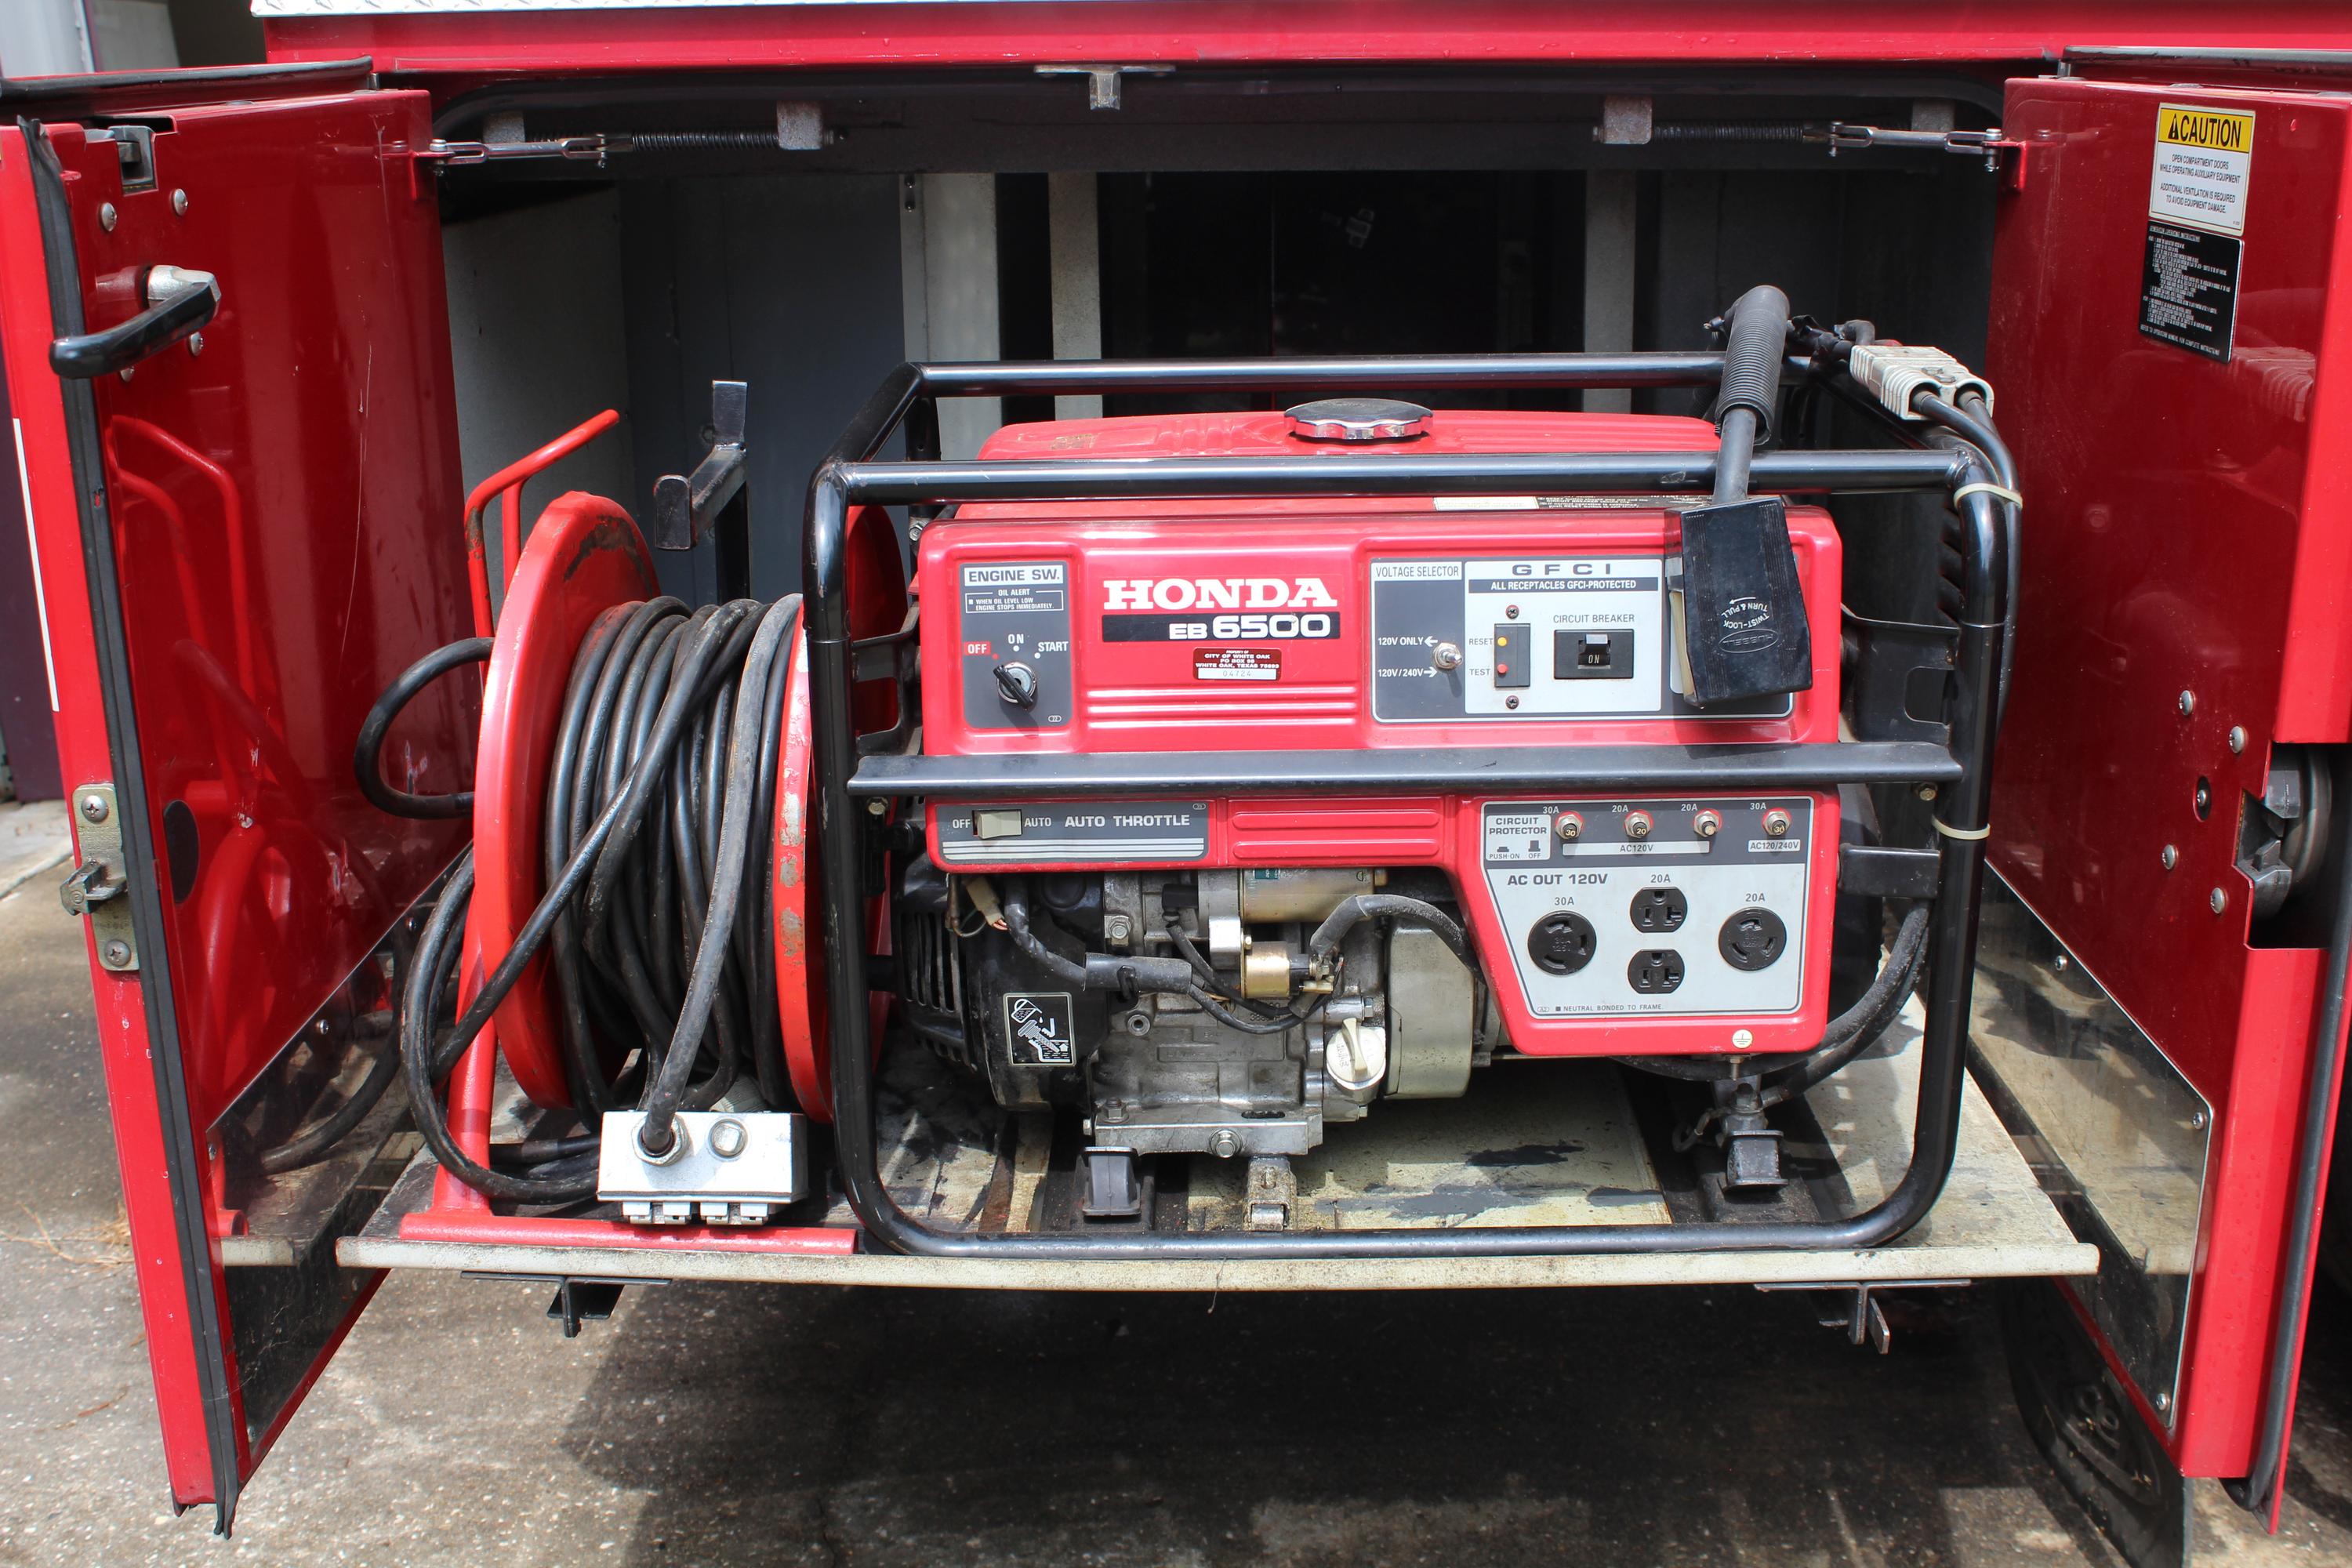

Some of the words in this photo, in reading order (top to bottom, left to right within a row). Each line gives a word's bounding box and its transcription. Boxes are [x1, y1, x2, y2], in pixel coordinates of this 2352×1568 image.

[2180, 114, 2242, 148] CAUTION
[2171, 154, 2183, 163] OPEN
[2183, 155, 2214, 169] COMPARTMENT
[2213, 160, 2229, 170] DOORS
[2159, 163, 2172, 172] WHILE
[2172, 165, 2194, 177] OPERATING
[2194, 169, 2216, 181] AUXILIARY
[2216, 173, 2241, 184] EQUIPMENT
[2160, 182, 2183, 194] ADDITIONAL
[2183, 187, 2209, 198] VENTILATION
[2209, 191, 2214, 199] IS
[2214, 192, 2236, 204] REQUIRED
[2166, 194, 2172, 203] TO
[2172, 196, 2184, 205] AVOID
[2184, 198, 2208, 210] EQUIPMENT
[968, 569, 1025, 583] ENGINE
[1032, 568, 1060, 581] SW.
[1376, 566, 1414, 578] VOLTAGE
[1417, 566, 1459, 577] SELECTOR
[1491, 581, 1506, 590] ALL
[1508, 580, 1566, 590] RECEPTACLES
[1567, 579, 1636, 590] GFCI-PROTECTED
[1103, 578, 1338, 610] HONDA
[1721, 605, 1740, 618] PULL
[1748, 602, 1769, 612] TURN
[1553, 615, 1589, 623] CIRCUIT
[1592, 614, 1635, 623] BREAKER
[1722, 613, 1769, 629] TWIST-LOCK
[1008, 633, 1024, 644] ON
[1377, 637, 1398, 646] 120V
[1399, 637, 1424, 646] ONLY
[967, 644, 987, 654] OFF
[1037, 641, 1069, 652] START
[1588, 654, 1599, 663] ON
[1377, 668, 1424, 677] 120V/240V
[1542, 805, 1559, 815] 30A
[1612, 804, 1629, 813] 20A
[1681, 803, 1698, 812] 20A
[1750, 801, 1766, 811] 30A
[953, 818, 971, 829] OFF
[1024, 817, 1052, 827] AUTO
[1065, 815, 1105, 828] AUTO
[1113, 815, 1190, 827] THROTTLE
[1495, 817, 1539, 826] CIRCUIT
[1489, 826, 1548, 836] PROTECTOR
[1619, 844, 1653, 854] AC120V
[1750, 840, 1800, 851] AC120/240V
[1507, 874, 1530, 886] AC
[1533, 873, 1563, 885] OUT
[1568, 873, 1608, 885] 120V
[1650, 874, 1671, 884] 20A
[1554, 897, 1575, 906] 30A
[1745, 893, 1766, 902] 20A
